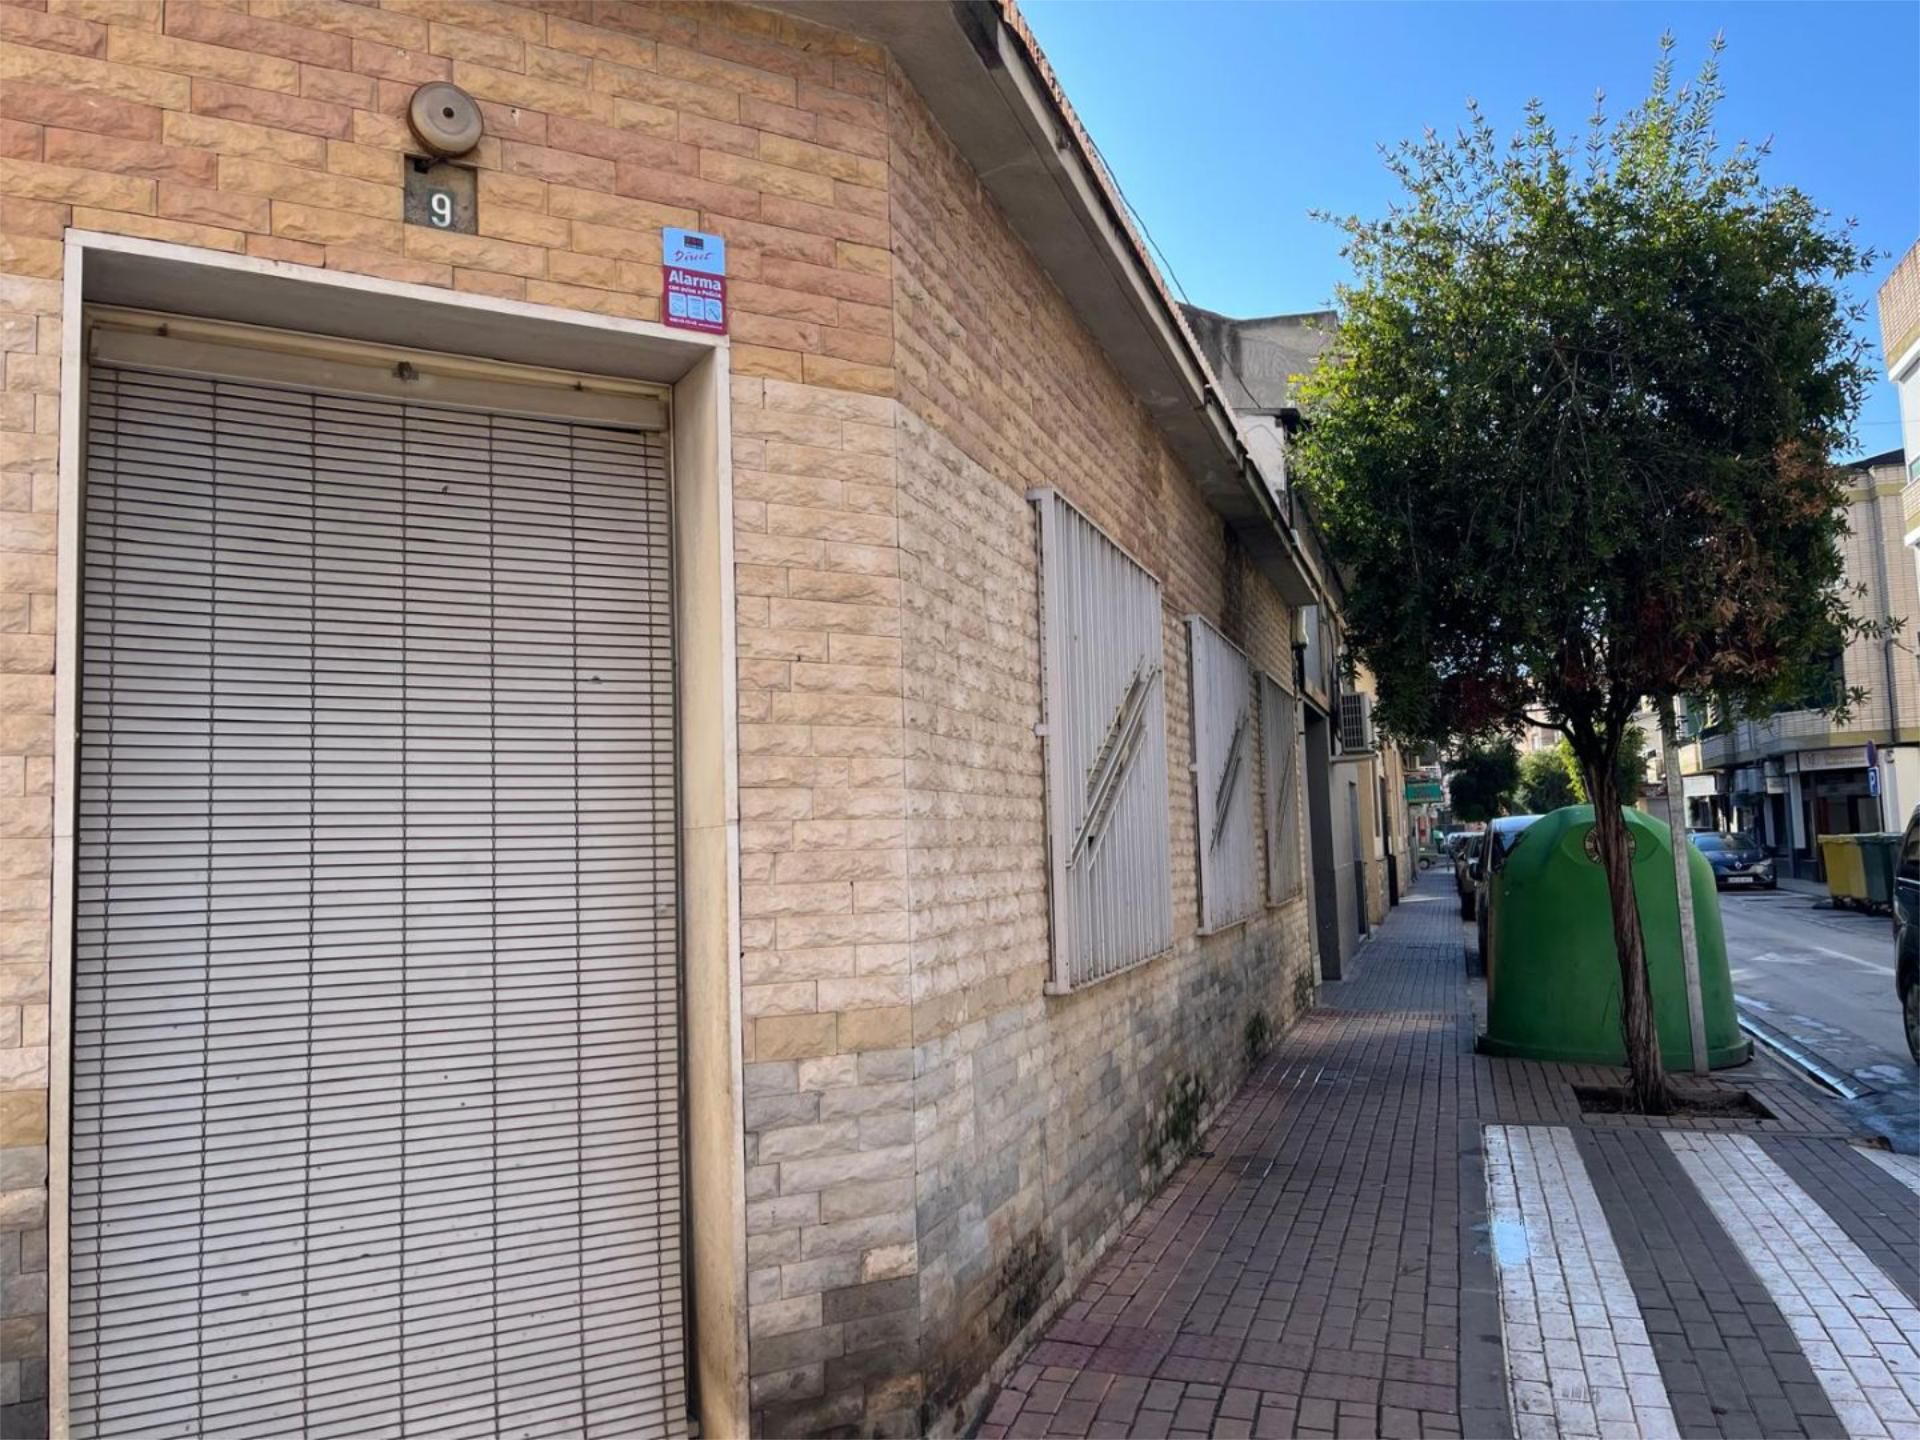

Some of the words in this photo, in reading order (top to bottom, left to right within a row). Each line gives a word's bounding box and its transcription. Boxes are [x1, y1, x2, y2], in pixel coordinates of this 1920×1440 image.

[431, 193, 452, 227] 9
[669, 270, 721, 290] Alarma
[1869, 771, 1876, 794] P
